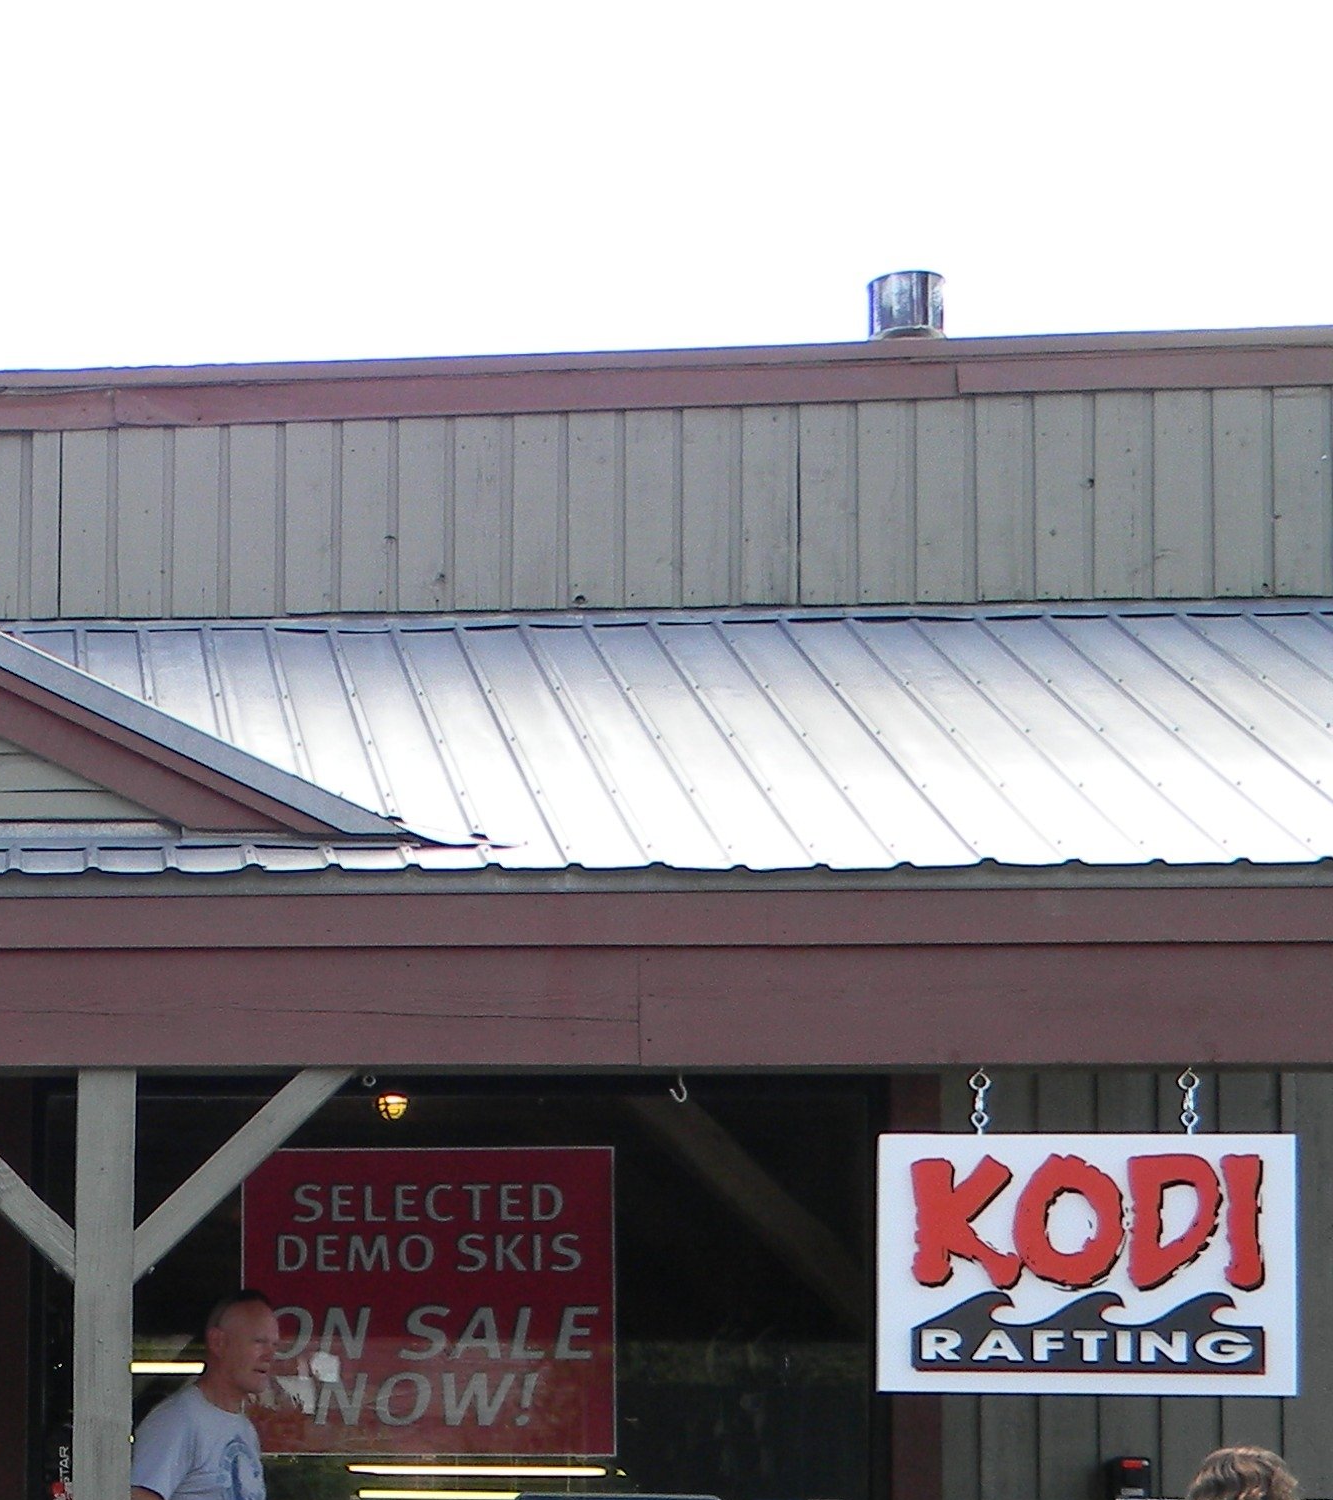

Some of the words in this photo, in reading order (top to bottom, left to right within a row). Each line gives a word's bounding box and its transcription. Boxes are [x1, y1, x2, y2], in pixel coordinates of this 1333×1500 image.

[292, 1183, 564, 1223] SELECTED
[910, 1152, 1266, 1292] KODI
[276, 1233, 435, 1273] DEMO
[456, 1232, 583, 1273] SKIS
[273, 1306, 371, 1361] ON
[398, 1305, 600, 1361] SALE
[919, 1327, 1255, 1365] RAFTING
[313, 1371, 541, 1427] NOW!
